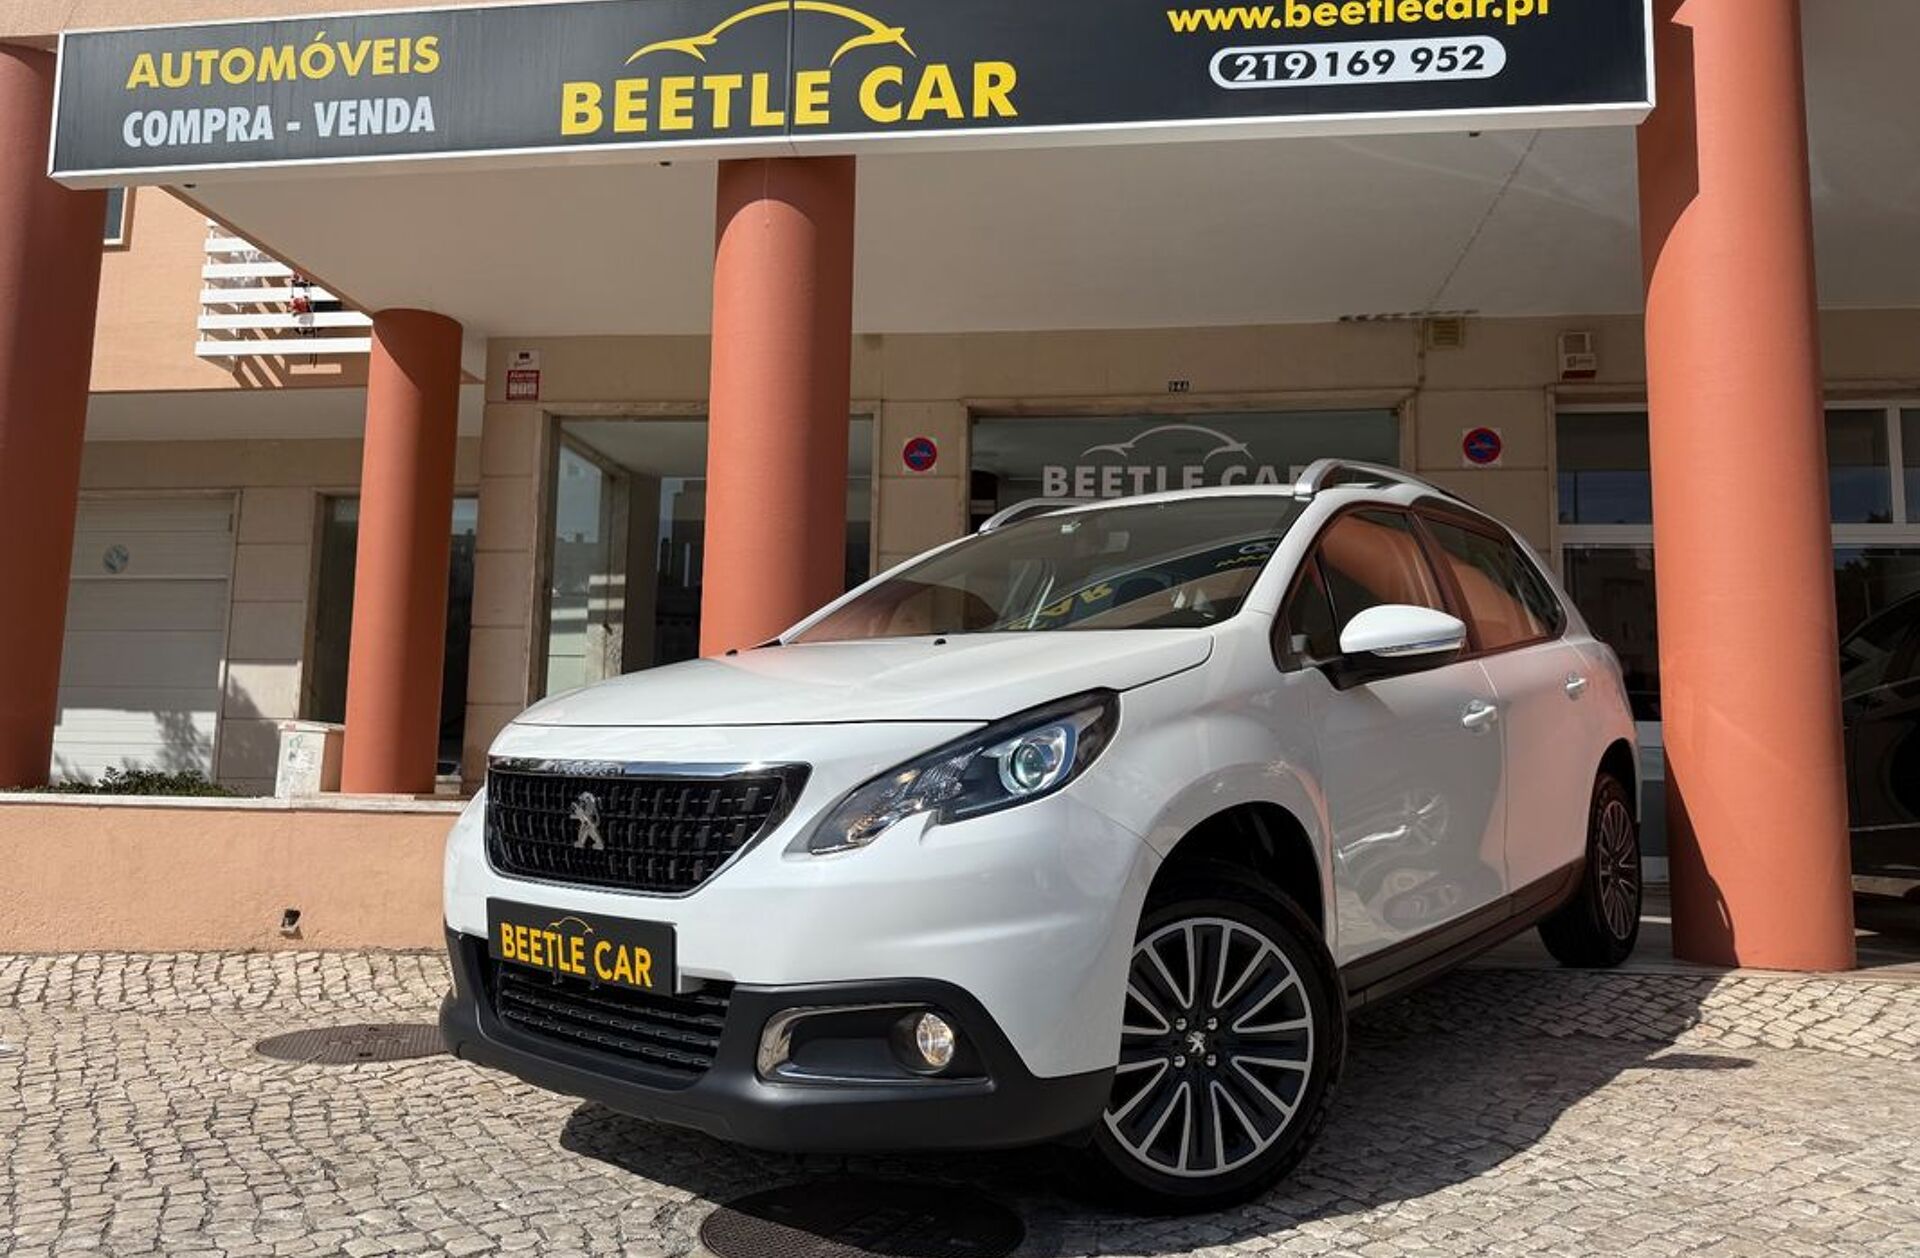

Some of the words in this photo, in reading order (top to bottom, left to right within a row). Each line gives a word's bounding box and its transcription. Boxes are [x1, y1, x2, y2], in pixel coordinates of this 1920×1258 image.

[126, 32, 441, 89] AUTOMÓVEIS
[1233, 54, 1308, 81] 219
[1325, 49, 1396, 77] 169
[1410, 45, 1485, 73] 952
[123, 105, 274, 147] COMPRA
[314, 96, 435, 136] VENDA
[561, 70, 831, 135] BEETLE
[858, 61, 1018, 122] CAR
[501, 922, 586, 975] BEETLE
[594, 940, 653, 988] CAR
